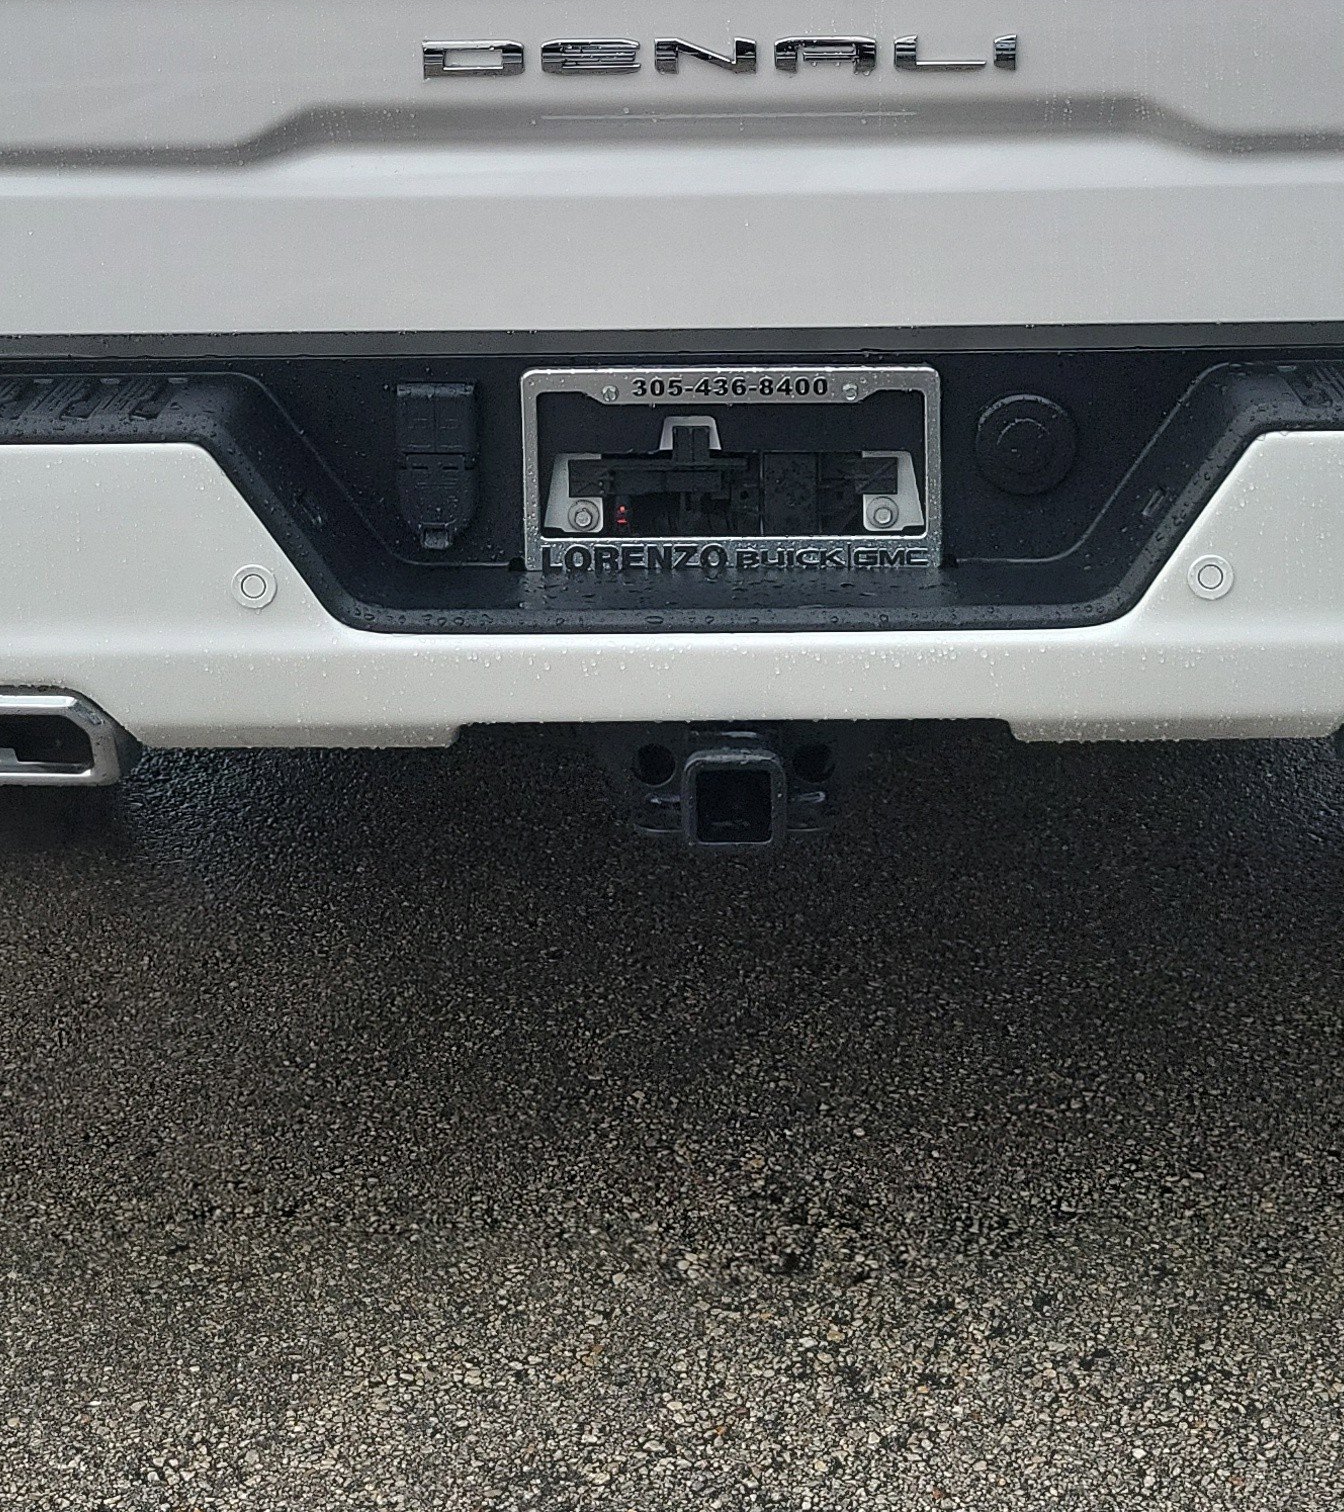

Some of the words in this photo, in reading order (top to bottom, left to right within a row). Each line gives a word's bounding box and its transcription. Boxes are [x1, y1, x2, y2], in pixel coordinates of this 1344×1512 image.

[421, 34, 1017, 80] DENALI
[631, 377, 829, 397] 305-436-8400
[541, 543, 728, 574] LORENZO
